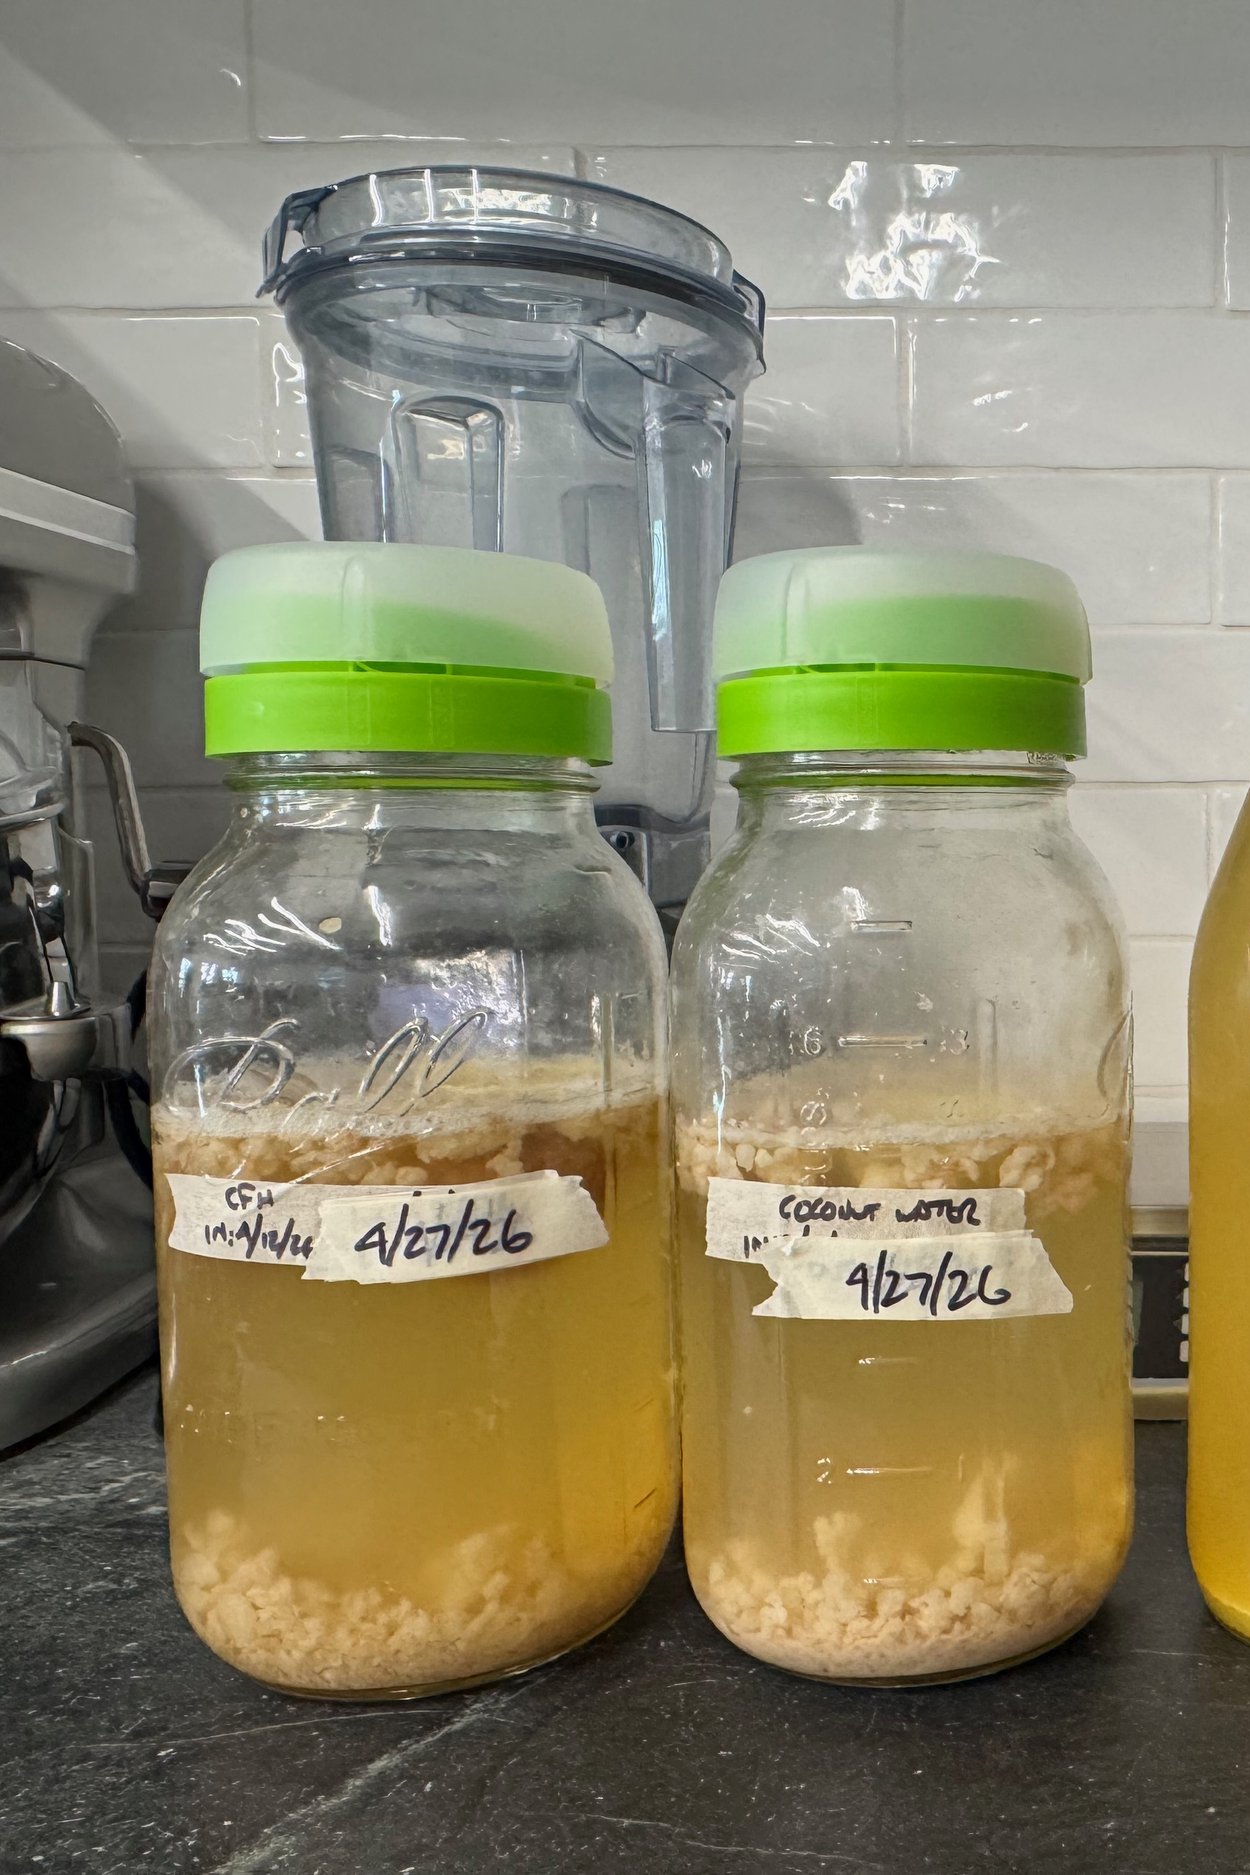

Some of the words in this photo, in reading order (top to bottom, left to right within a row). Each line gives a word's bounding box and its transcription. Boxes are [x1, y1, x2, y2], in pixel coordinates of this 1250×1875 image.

[225, 1182, 275, 1211] CFH
[778, 1193, 882, 1224] COCONUT
[353, 1198, 534, 1267] 4/27/26
[845, 1249, 1012, 1317] 4/27/26
